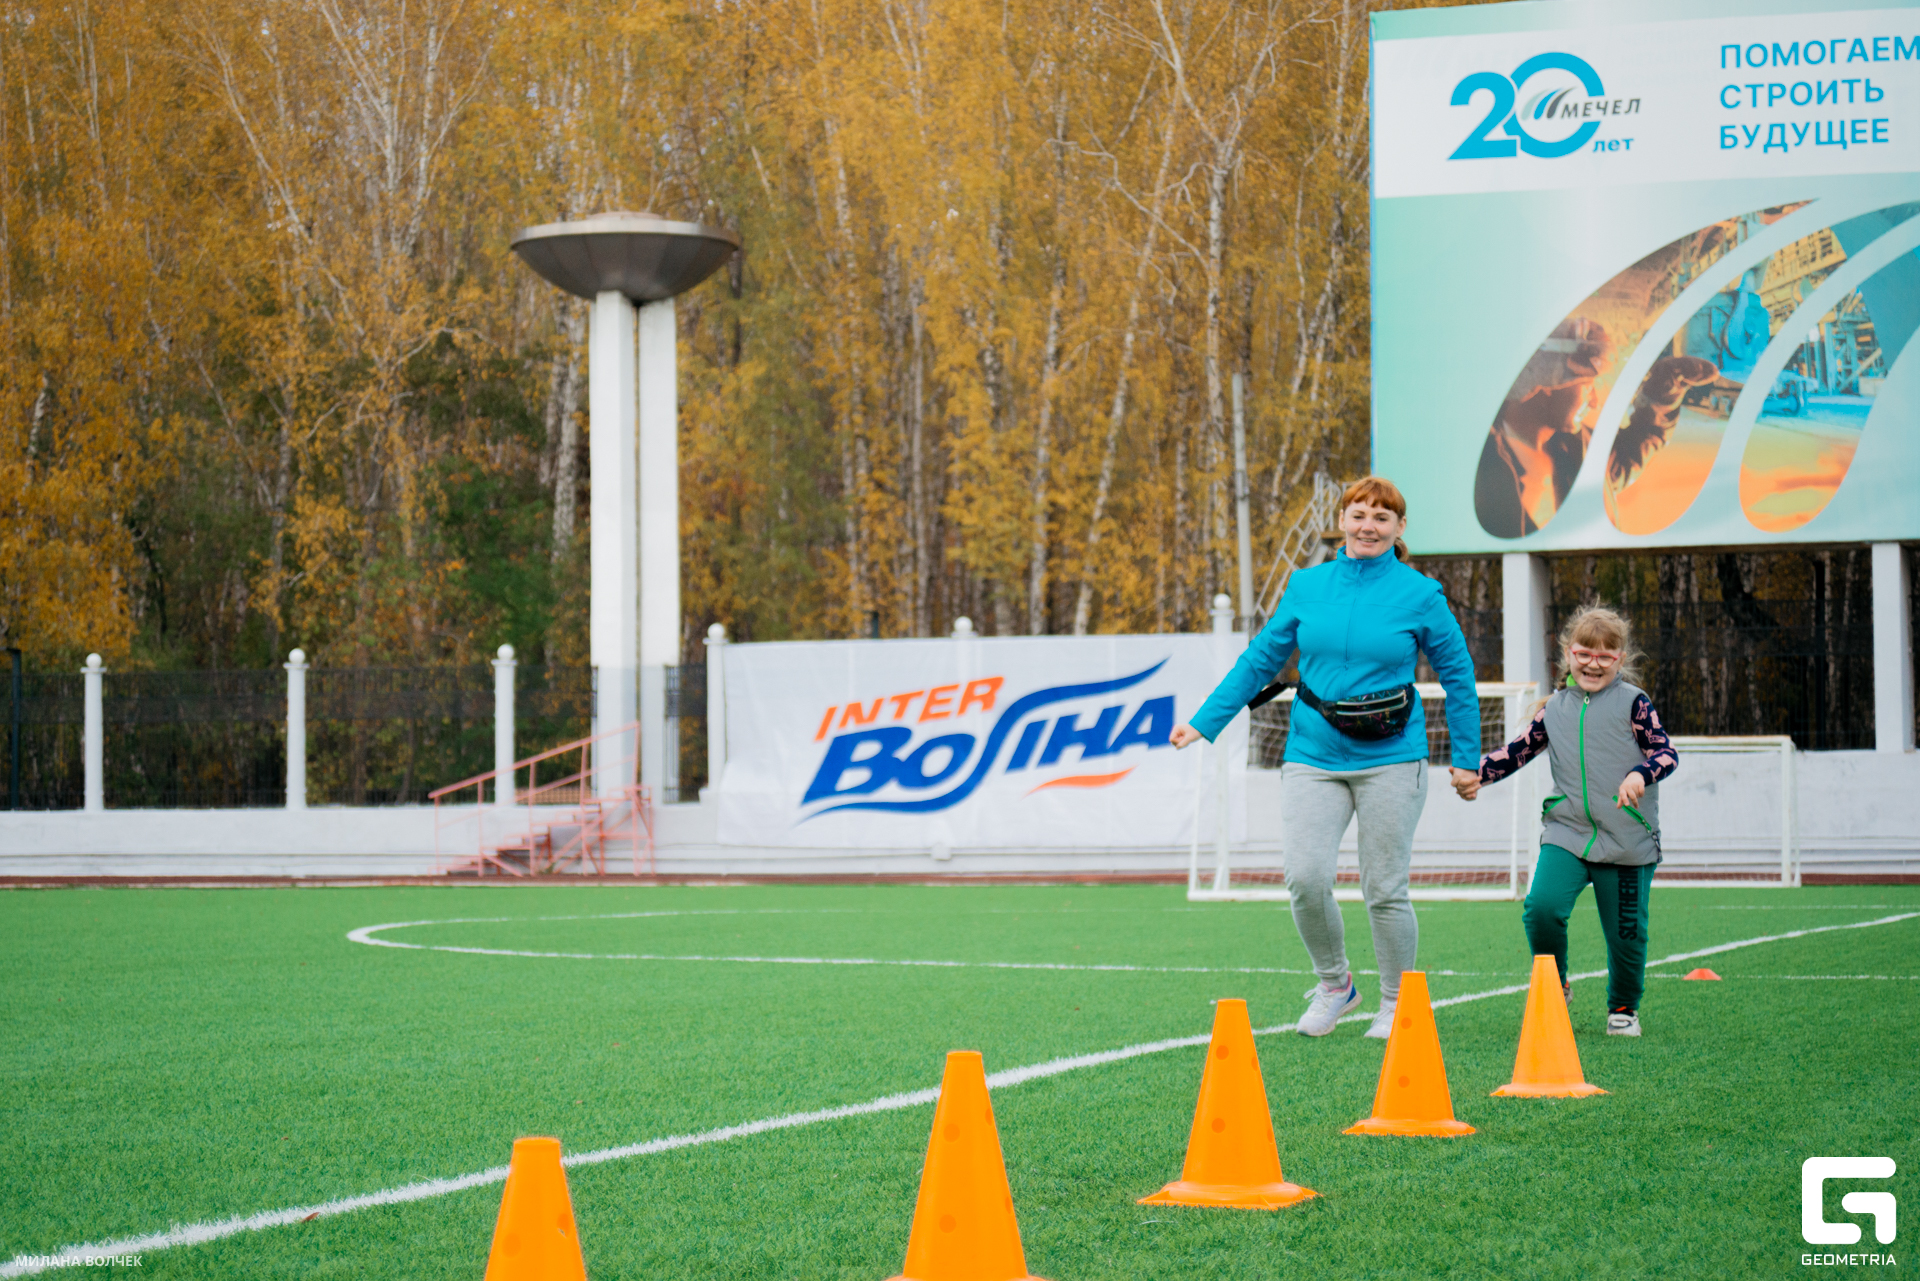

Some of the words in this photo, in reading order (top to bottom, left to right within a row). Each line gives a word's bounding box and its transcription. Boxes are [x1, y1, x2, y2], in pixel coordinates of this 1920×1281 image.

[1720, 35, 1920, 69] ПОМОГАЕМ
[1447, 51, 1606, 160] 20
[1560, 97, 1642, 120] МЕЧЕЛ
[1719, 78, 1884, 109] СТРОИТЬ
[1592, 136, 1634, 154] лет
[1719, 118, 1889, 153] БУДУЩЕЕ
[813, 676, 1005, 743] INTER
